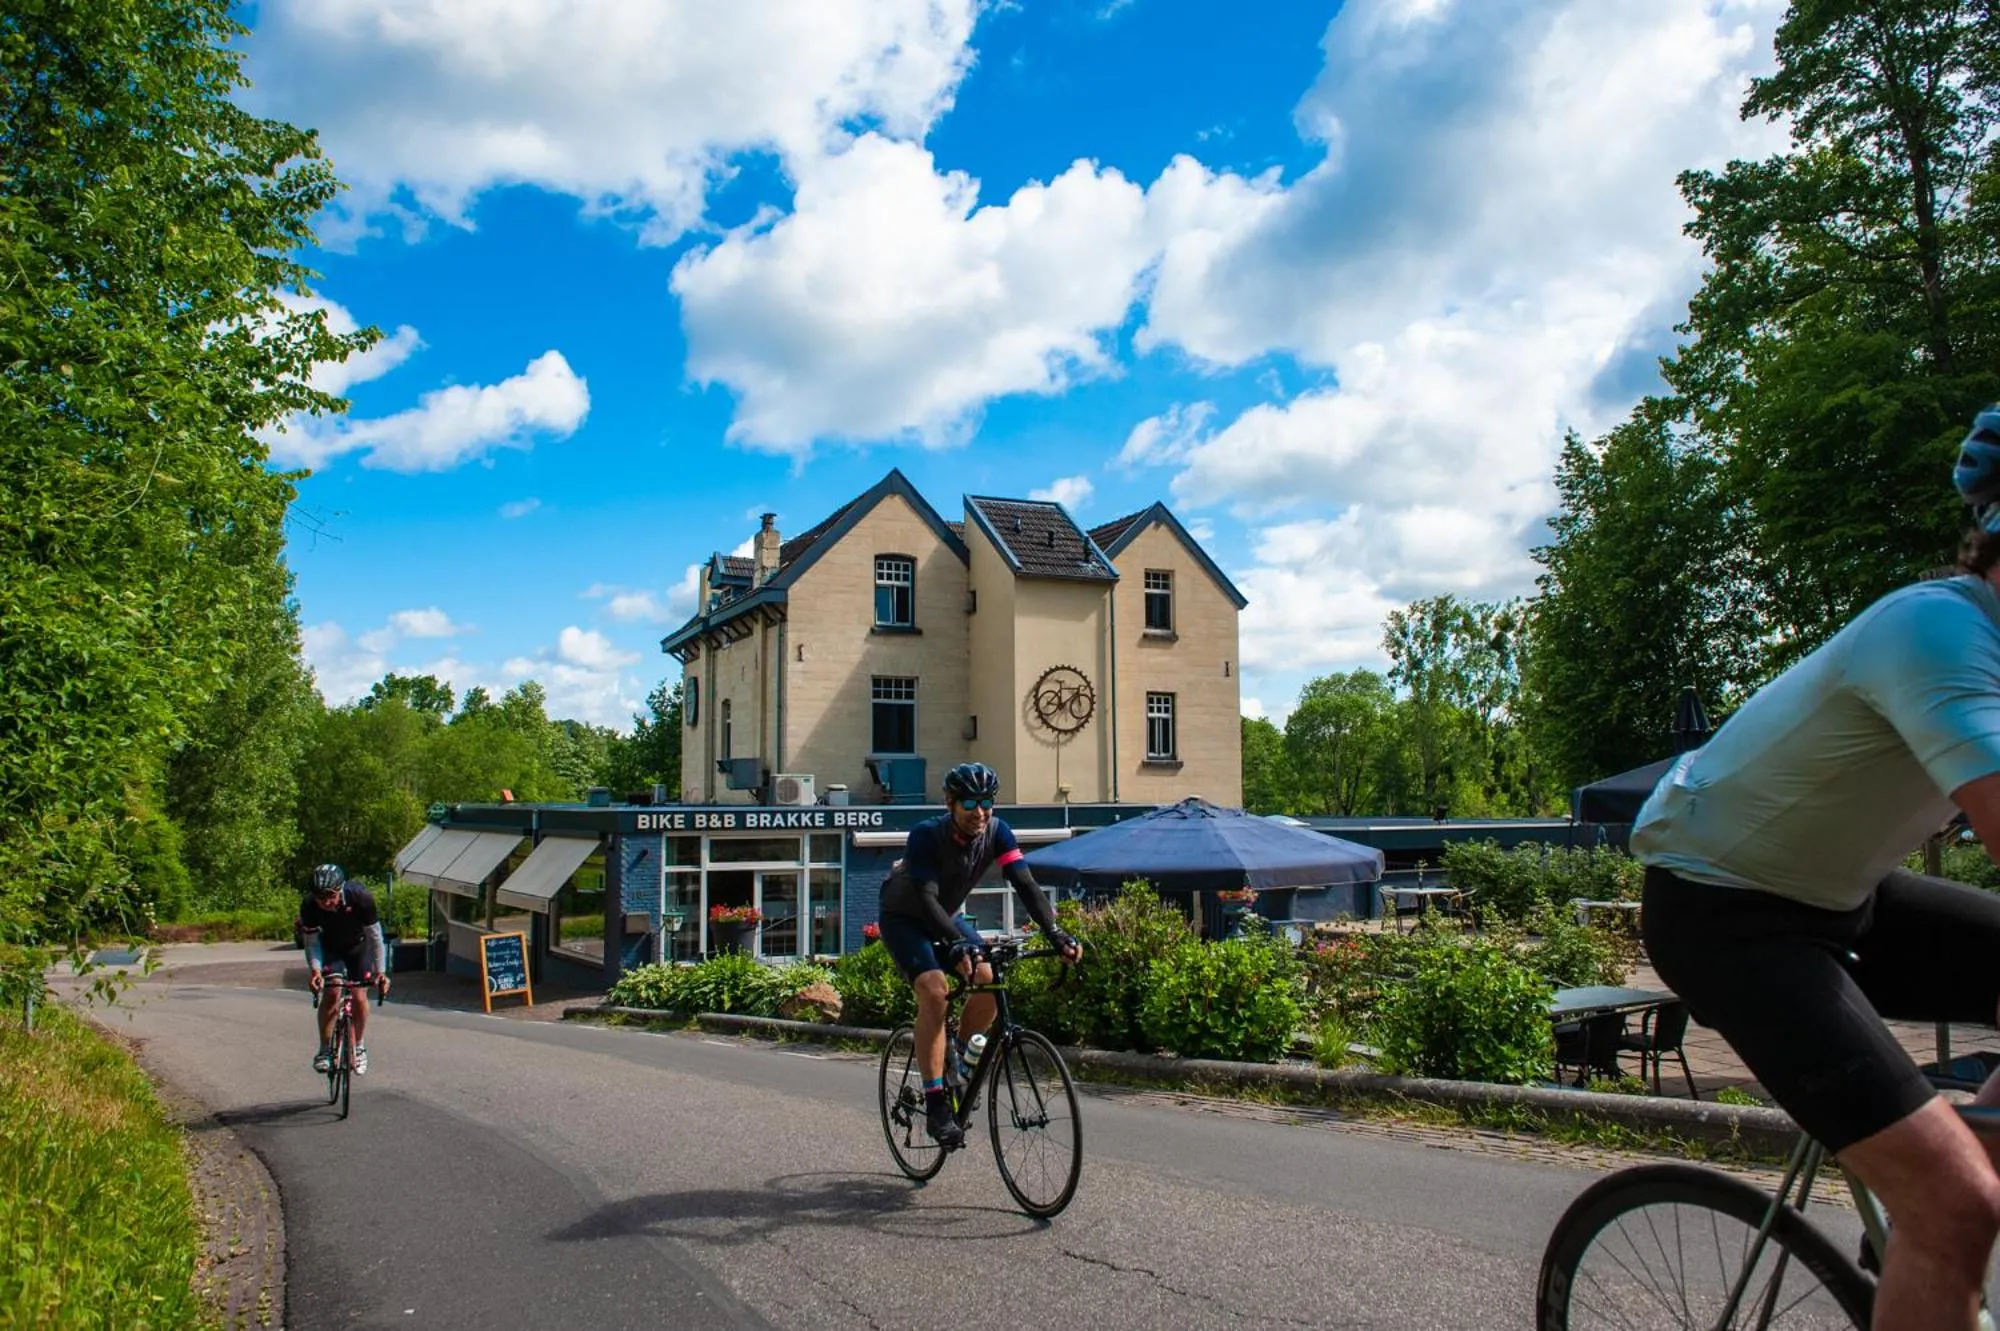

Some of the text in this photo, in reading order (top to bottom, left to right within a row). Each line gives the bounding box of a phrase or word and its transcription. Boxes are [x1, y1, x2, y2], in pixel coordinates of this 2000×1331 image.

[637, 811, 883, 829] BIKE B&B BRAKKE BERG
